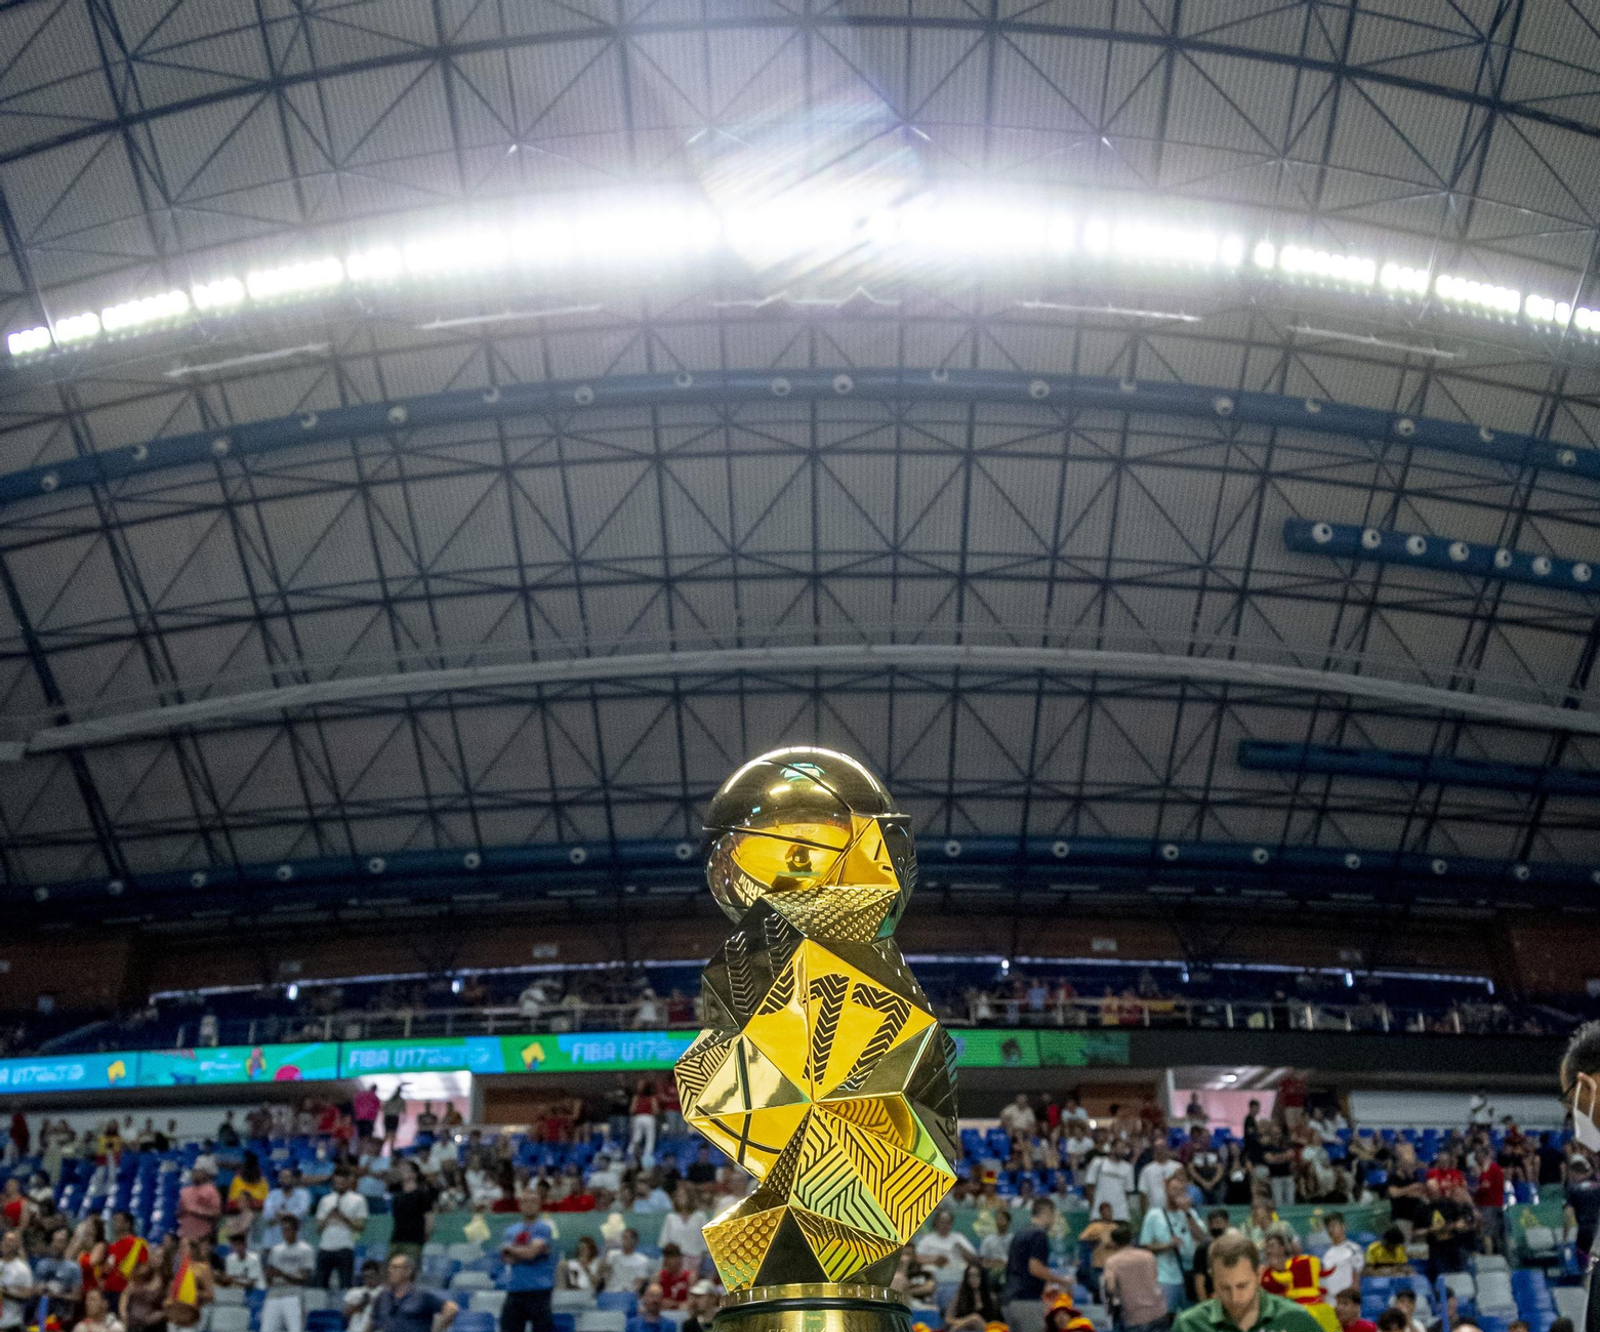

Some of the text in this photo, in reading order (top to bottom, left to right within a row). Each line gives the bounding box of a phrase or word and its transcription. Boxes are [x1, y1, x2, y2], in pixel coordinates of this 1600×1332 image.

[348, 1048, 390, 1069] FIBA
[394, 1047, 427, 1067] U17
[571, 1040, 617, 1064] FIBA
